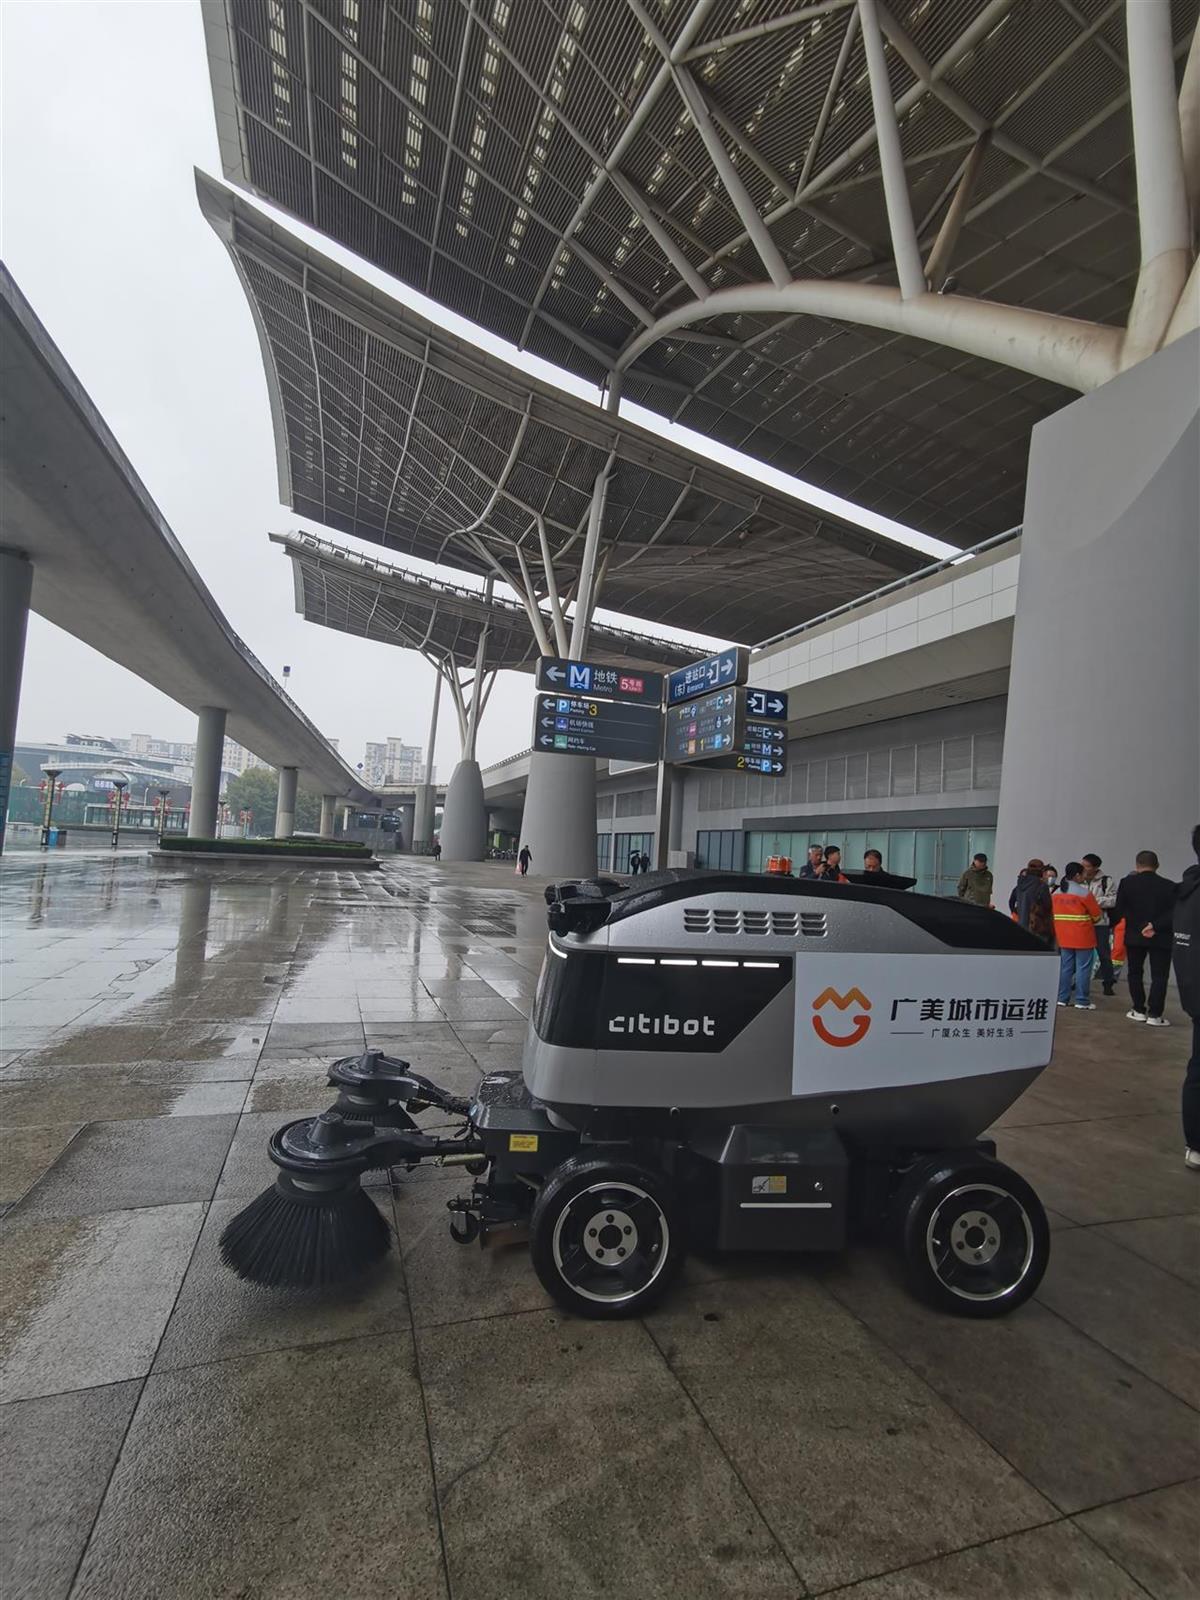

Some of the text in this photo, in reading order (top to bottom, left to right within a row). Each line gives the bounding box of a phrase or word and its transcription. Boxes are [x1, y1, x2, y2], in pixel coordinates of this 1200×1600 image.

[593, 669, 618, 684] 地铁
[685, 665, 705, 684] 进站口
[593, 684, 613, 693] Metro
[589, 704, 598, 716] 3
[737, 756, 745, 768] 2
[890, 998, 1049, 1022] 广美城市运维
[608, 1013, 715, 1036] citibot
[931, 1028, 1014, 1038] 广厦众生 美好生活
